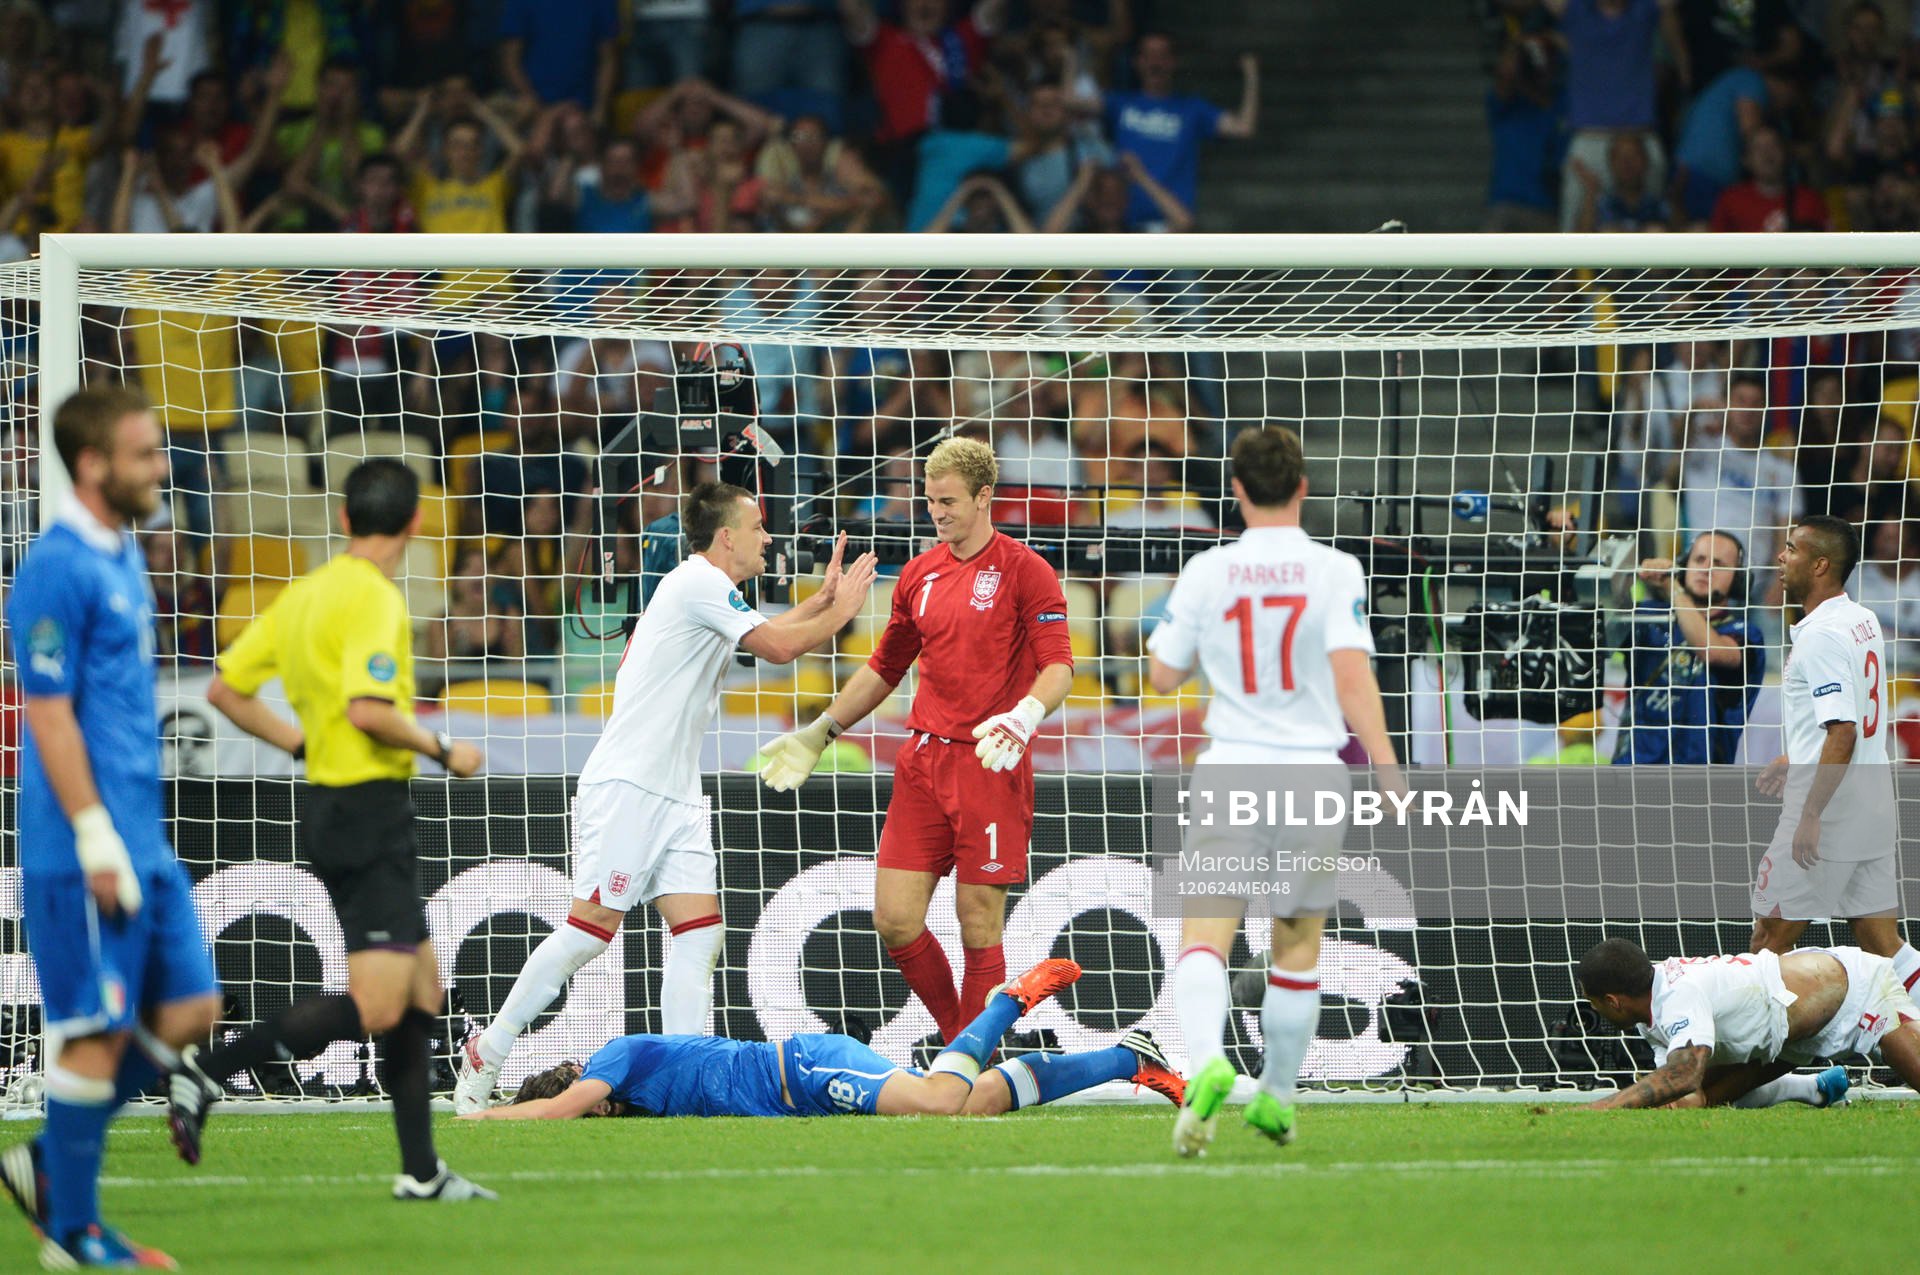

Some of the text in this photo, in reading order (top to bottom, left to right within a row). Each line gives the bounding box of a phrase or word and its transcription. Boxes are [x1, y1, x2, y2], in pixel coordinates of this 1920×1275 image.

[1228, 562, 1306, 585] PARKER
[919, 581, 933, 617] 1
[1223, 593, 1308, 695] 17
[1863, 650, 1880, 739] 3
[985, 822, 998, 860] 1
